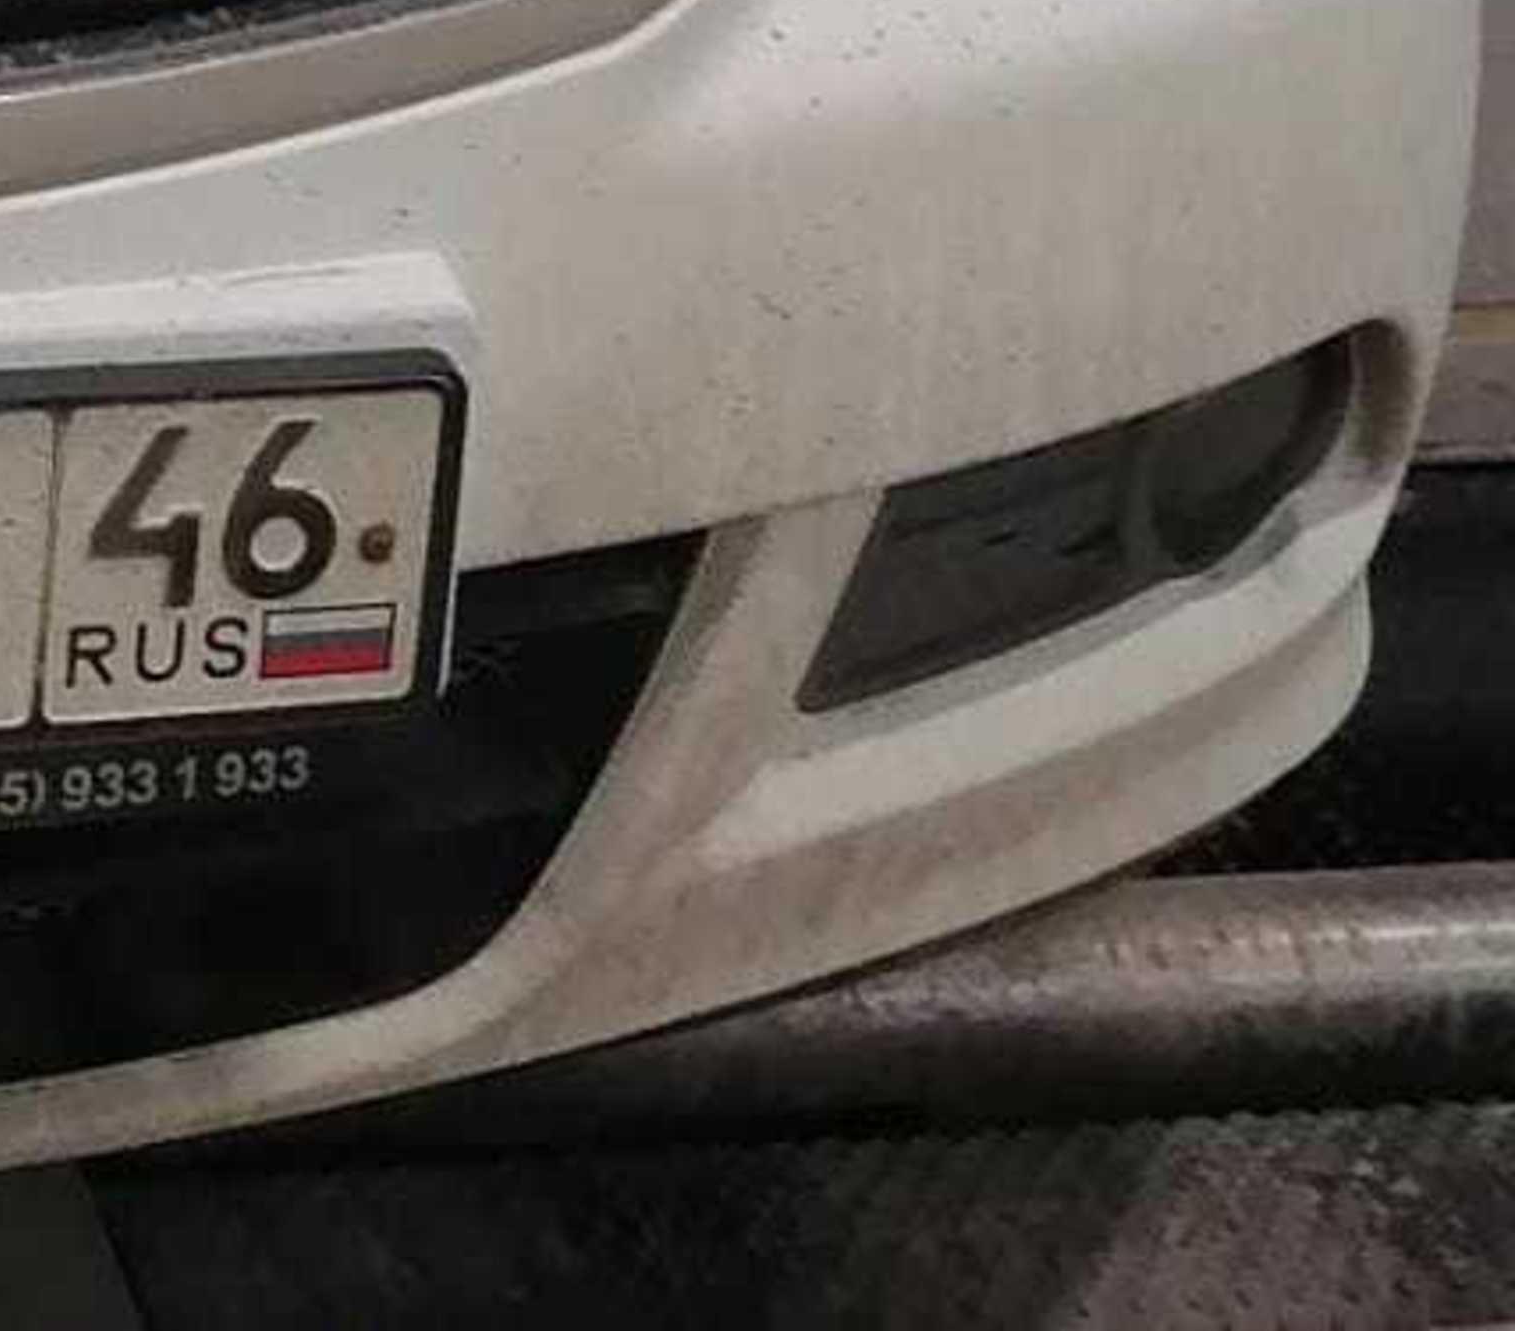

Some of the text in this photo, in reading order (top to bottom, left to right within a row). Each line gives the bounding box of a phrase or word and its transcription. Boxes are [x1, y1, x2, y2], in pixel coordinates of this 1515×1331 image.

[89, 420, 338, 608] 46
[64, 617, 250, 689] RUS
[61, 759, 159, 811] 933
[174, 755, 199, 800] 1
[214, 745, 311, 797] 933
